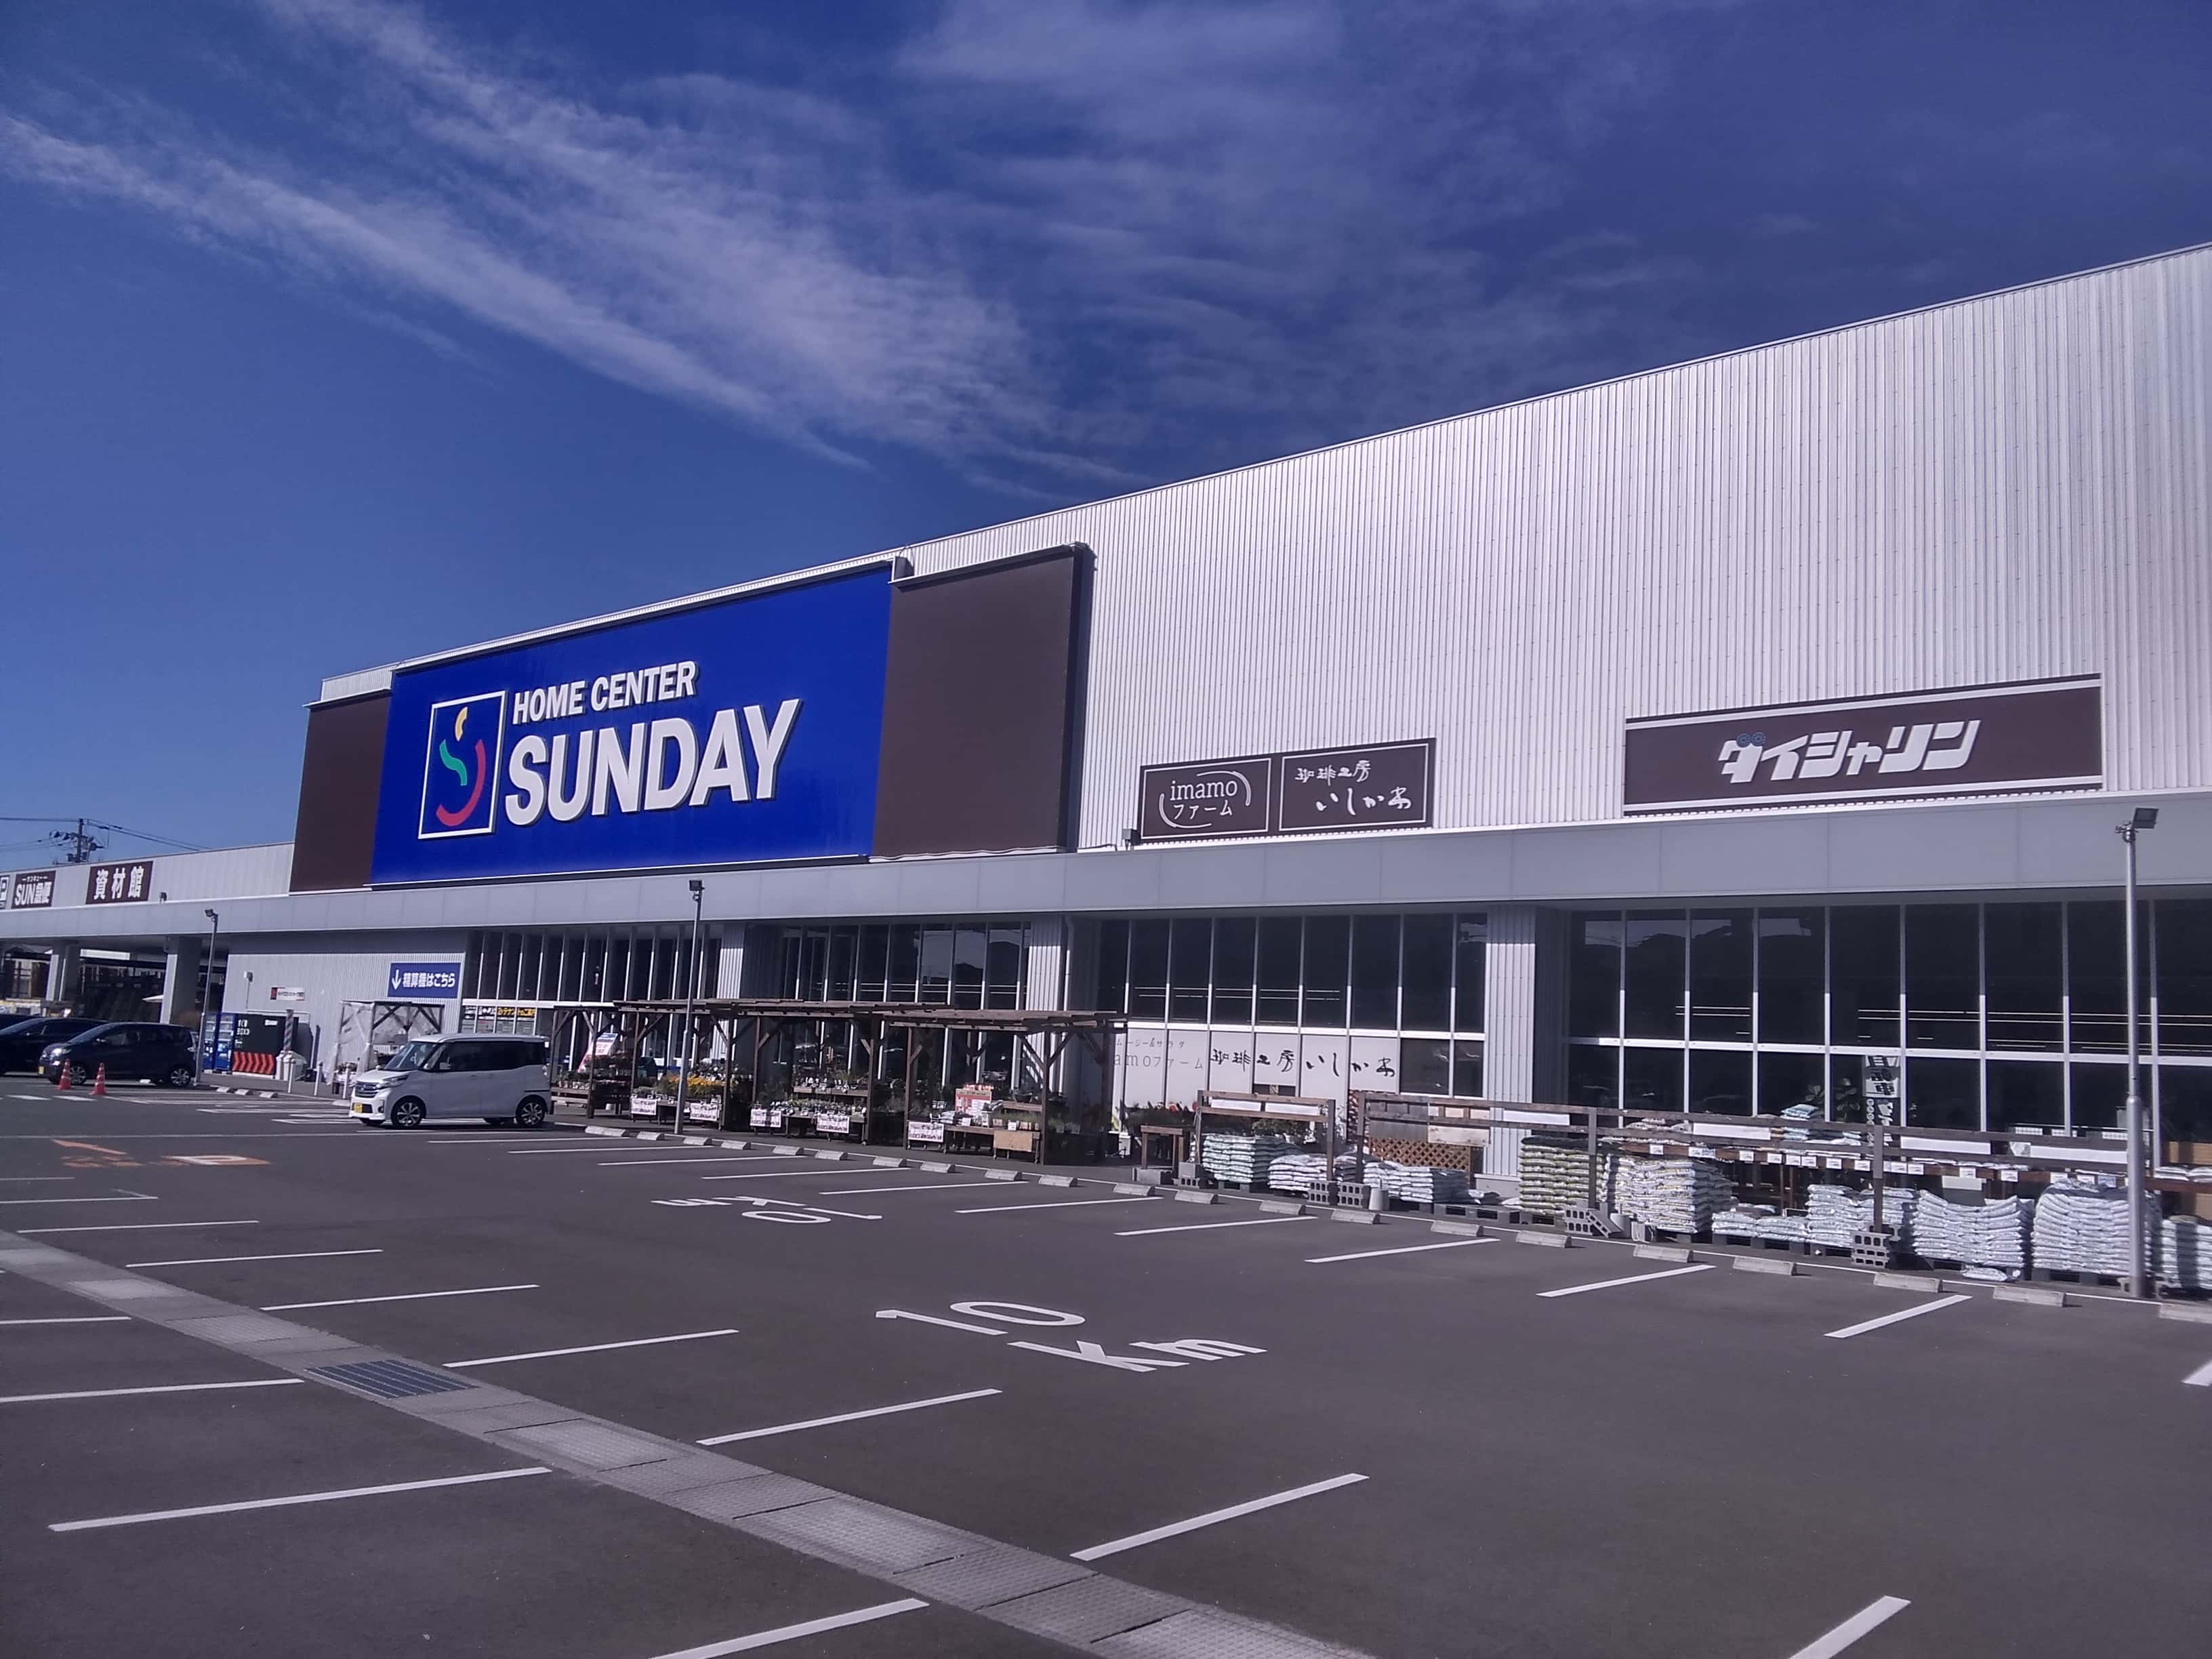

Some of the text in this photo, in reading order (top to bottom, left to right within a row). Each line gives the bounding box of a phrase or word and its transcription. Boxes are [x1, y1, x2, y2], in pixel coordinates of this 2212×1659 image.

[512, 661, 697, 725] HOME CENTER
[505, 698, 802, 826] SUNDAY
[1717, 720, 1982, 783] ダイシャリン
[1294, 759, 1372, 786] 珈琲工房
[1170, 779, 1238, 802] imamo
[1172, 800, 1233, 820] ファーム
[94, 865, 144, 901] 資材館
[741, 1207, 882, 1224] 10
[876, 1301, 1086, 1335] 10
